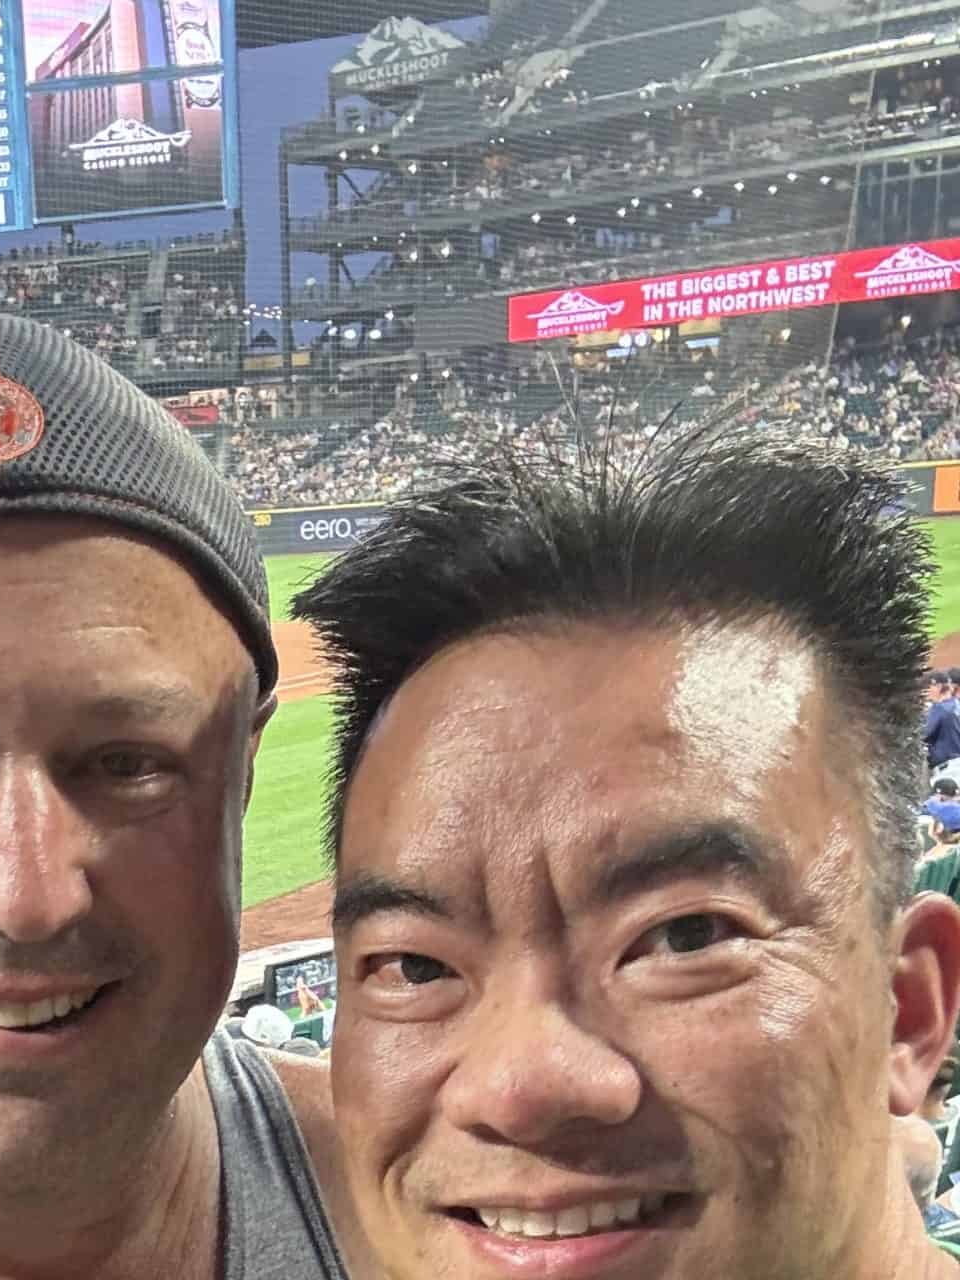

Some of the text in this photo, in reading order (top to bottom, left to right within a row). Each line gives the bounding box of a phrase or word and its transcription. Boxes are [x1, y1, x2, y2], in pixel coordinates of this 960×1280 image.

[346, 52, 449, 86] MUCKLESHOOT
[640, 260, 836, 301] THE BIGGEST & BEST
[866, 267, 953, 289] MUCKLESHOOT
[643, 283, 830, 321] IN THE NORTHWEST
[537, 310, 608, 330] MUCKLESHOOT
[300, 517, 352, 541] eero
